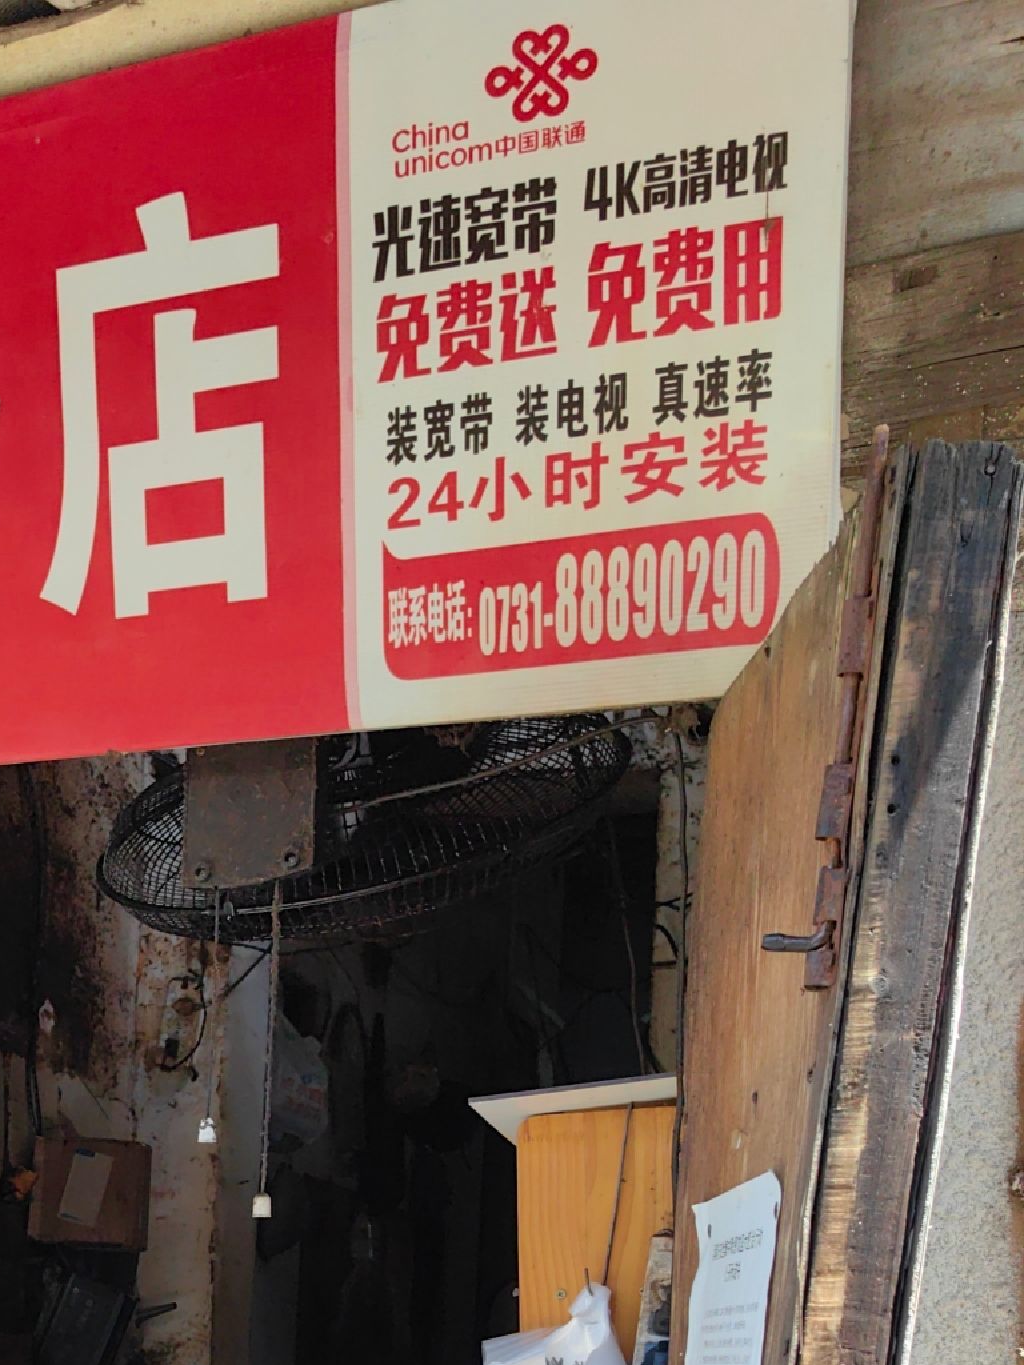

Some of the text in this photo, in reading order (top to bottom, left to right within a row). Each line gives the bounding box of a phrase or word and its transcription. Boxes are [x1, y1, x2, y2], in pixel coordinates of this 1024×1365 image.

[391, 120, 470, 153] China
[394, 120, 587, 179] unicom 中国联通
[372, 131, 789, 284] 光速宽带 4K高清电视
[376, 215, 784, 384] 免费送 免费用
[386, 348, 773, 467] 装宽带 装电视 真速率
[387, 420, 769, 530] 24小时安装
[478, 529, 766, 657] 0731-88890290
